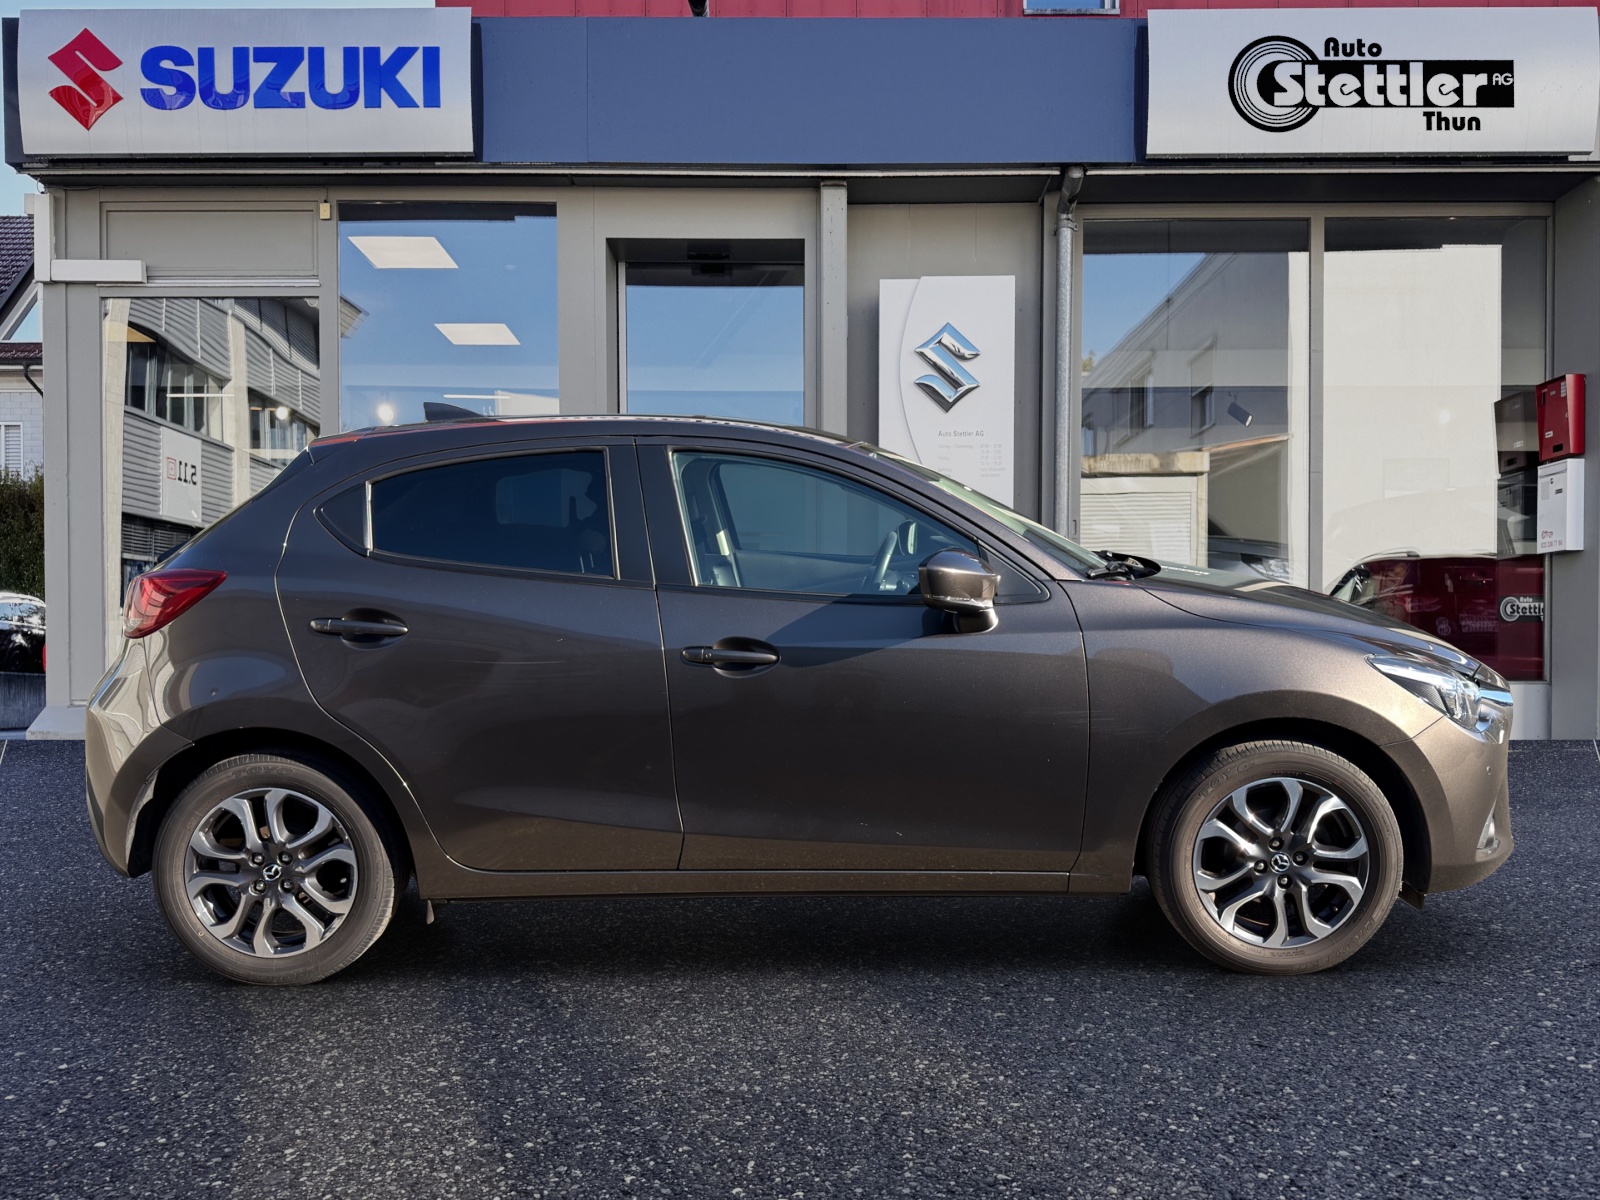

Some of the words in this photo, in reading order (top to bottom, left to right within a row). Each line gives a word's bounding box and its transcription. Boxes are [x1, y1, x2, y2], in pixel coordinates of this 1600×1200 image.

[1323, 37, 1383, 58] Auto
[140, 45, 441, 110] SUZUKI
[1273, 61, 1488, 107] Stettler
[1492, 73, 1514, 86] AG
[1423, 111, 1481, 131] Thun
[1509, 603, 1544, 615] Stettl
